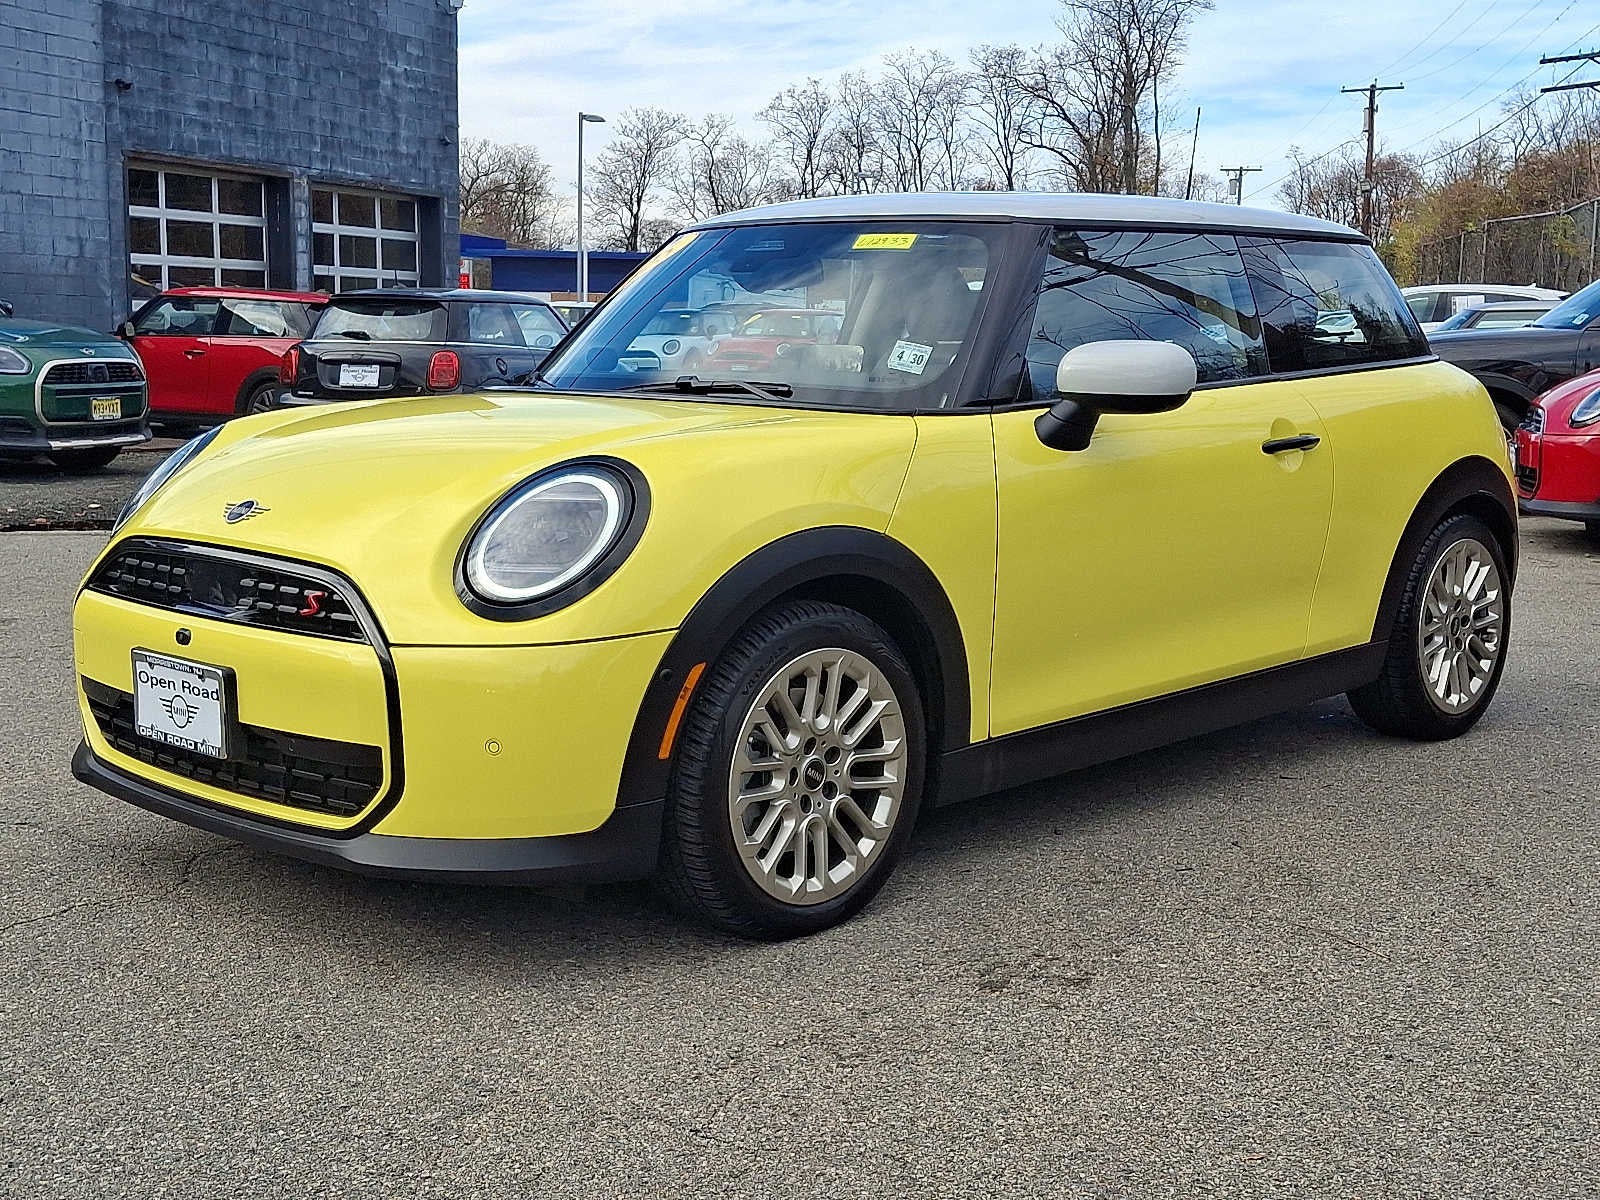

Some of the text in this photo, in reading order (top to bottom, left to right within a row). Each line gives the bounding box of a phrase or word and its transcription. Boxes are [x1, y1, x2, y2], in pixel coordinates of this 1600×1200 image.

[896, 350, 924, 365] 4 30
[139, 671, 220, 701] Open Road
[173, 706, 187, 718] MINI
[140, 728, 219, 757] OPEN ROAD MINI
[807, 767, 822, 781] MINI
